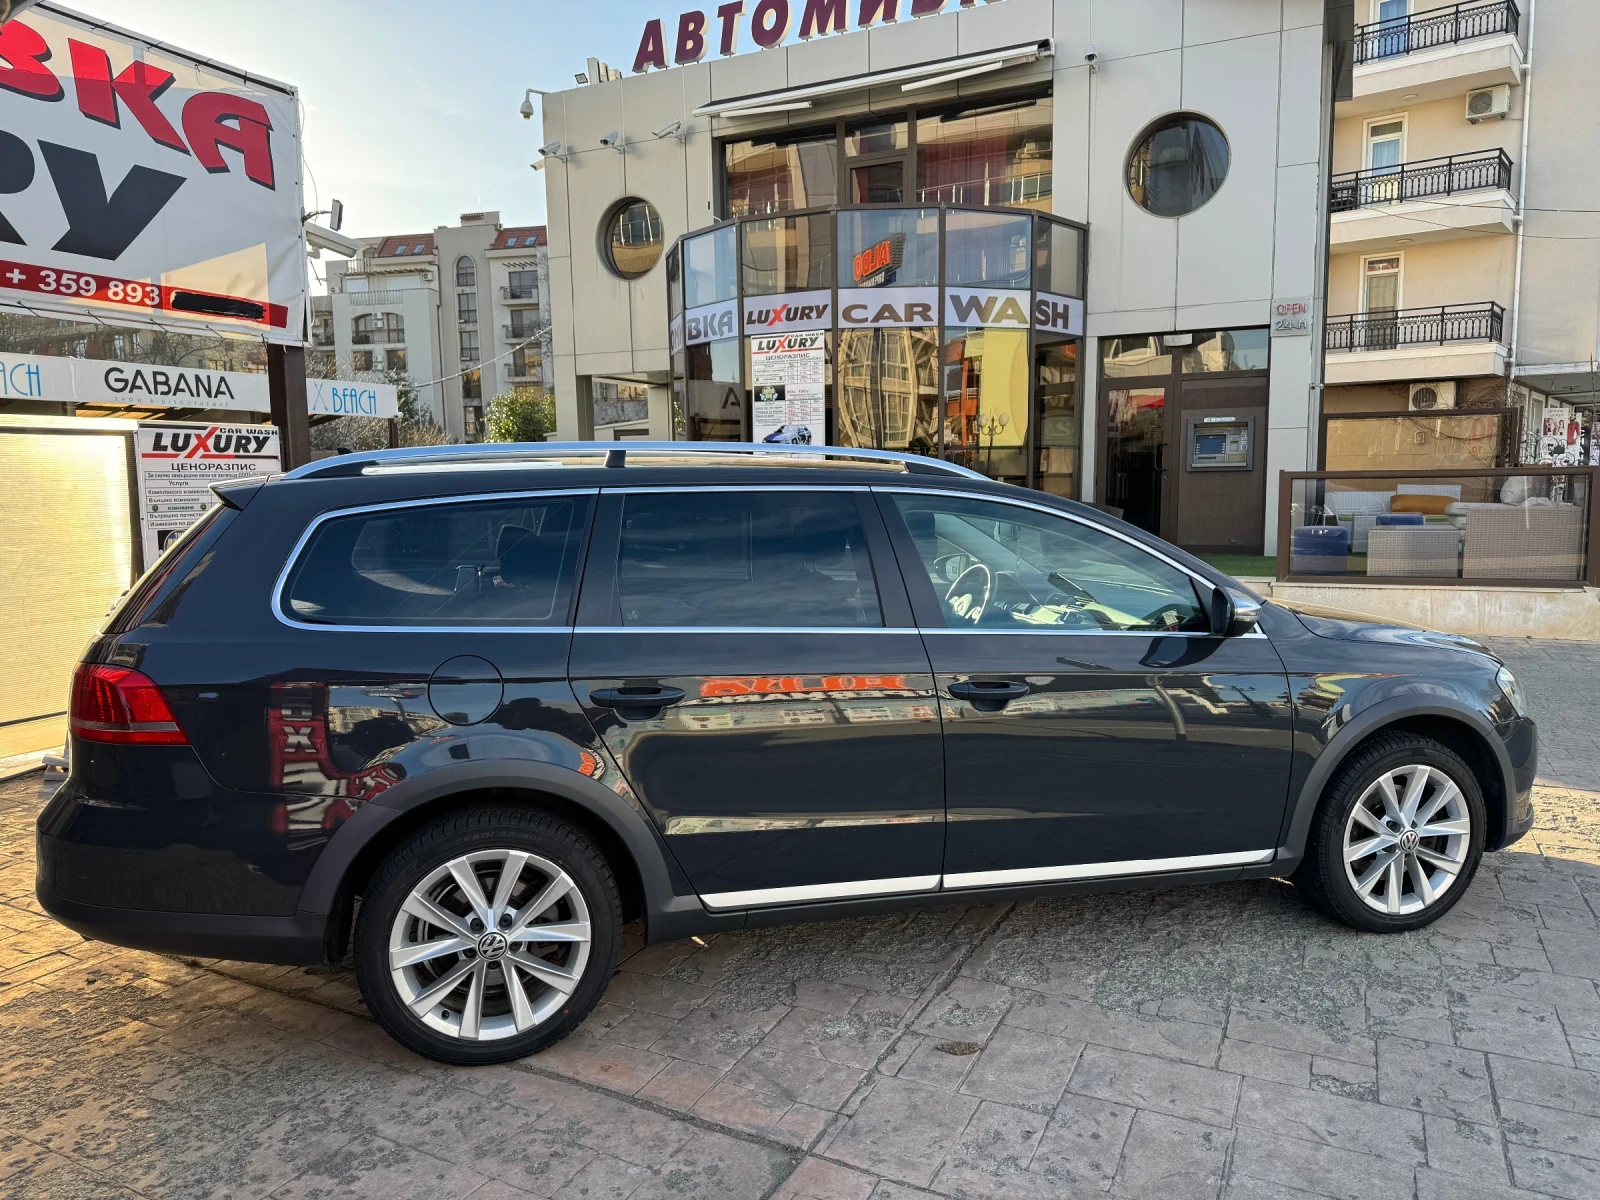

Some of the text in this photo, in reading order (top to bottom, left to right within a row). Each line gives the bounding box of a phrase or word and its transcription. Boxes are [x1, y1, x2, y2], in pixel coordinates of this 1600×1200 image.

[632, 0, 1004, 73] АВТОМИ
[38, 269, 97, 296] 359
[107, 280, 160, 306] 893
[746, 303, 829, 327] LUXURY
[841, 302, 935, 324] CAR
[1276, 303, 1307, 316] OPEN
[757, 334, 819, 354] LUXURY
[104, 366, 235, 400] GABANA
[114, 395, 143, 403] SHOW
[161, 399, 230, 408] DISCOTHEQUE
[332, 387, 377, 415] BEACH
[152, 426, 271, 459] LUXURY
[219, 427, 278, 436] CAR WASH
[171, 462, 256, 473] ЦЕНОРАЗПИС
